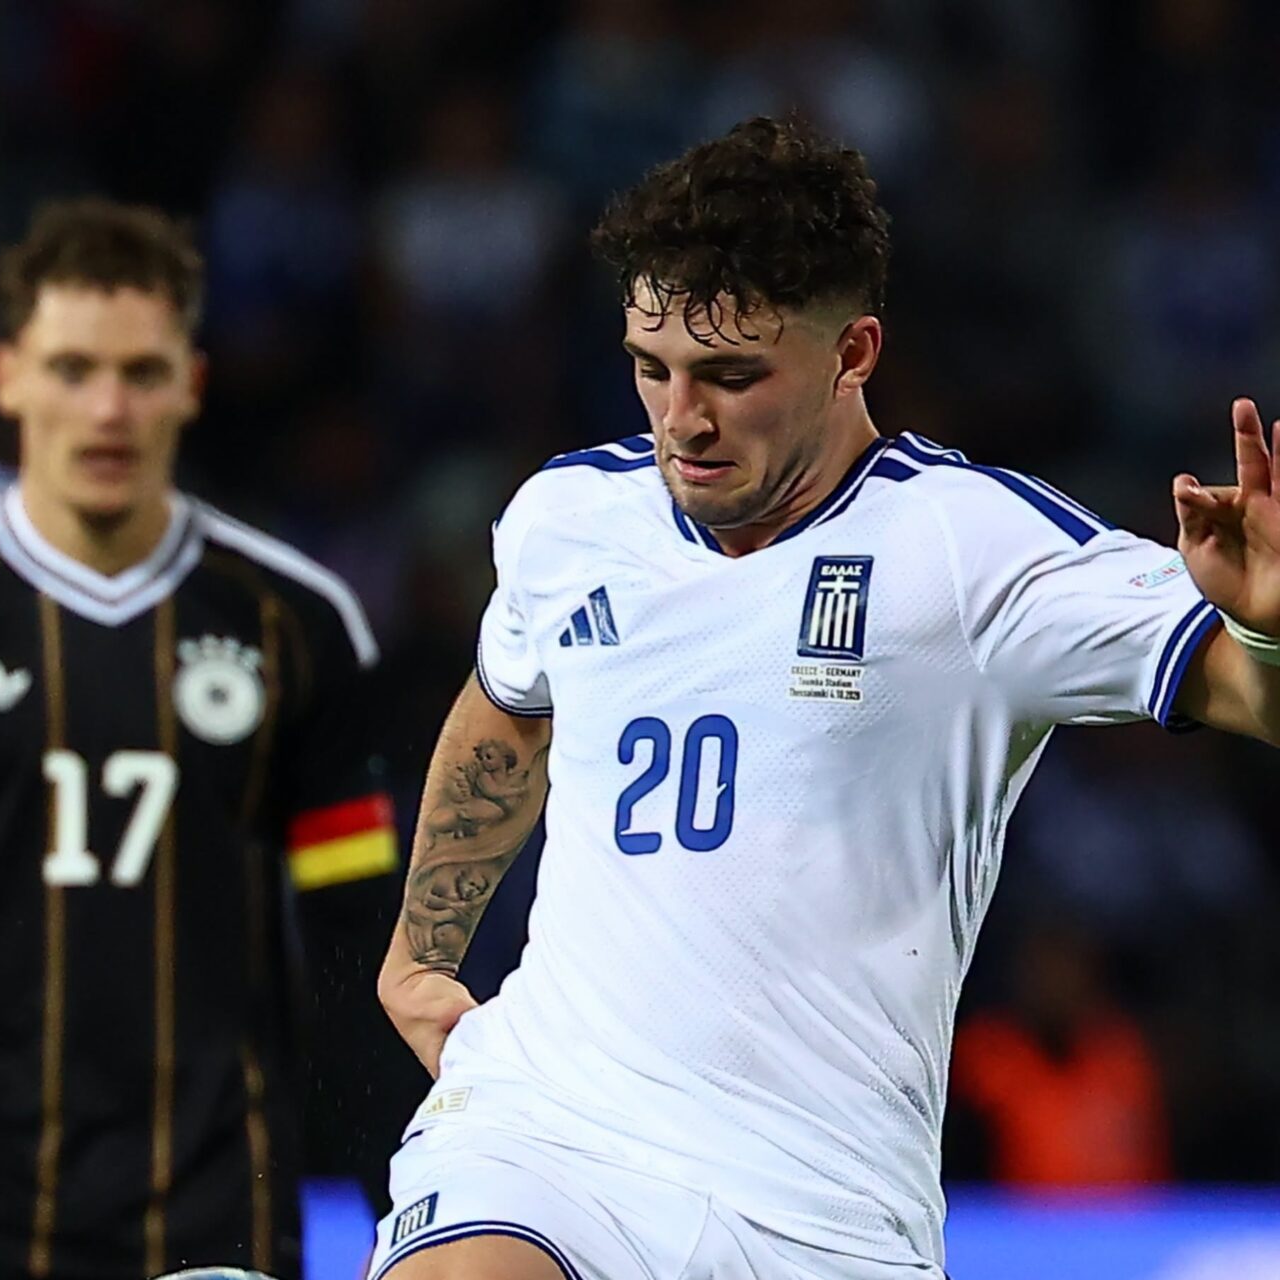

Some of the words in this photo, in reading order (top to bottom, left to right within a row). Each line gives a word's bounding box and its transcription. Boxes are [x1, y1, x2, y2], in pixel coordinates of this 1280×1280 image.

[825, 666, 862, 678] GERMANY
[41, 748, 181, 888] 17
[614, 713, 739, 856] 20
